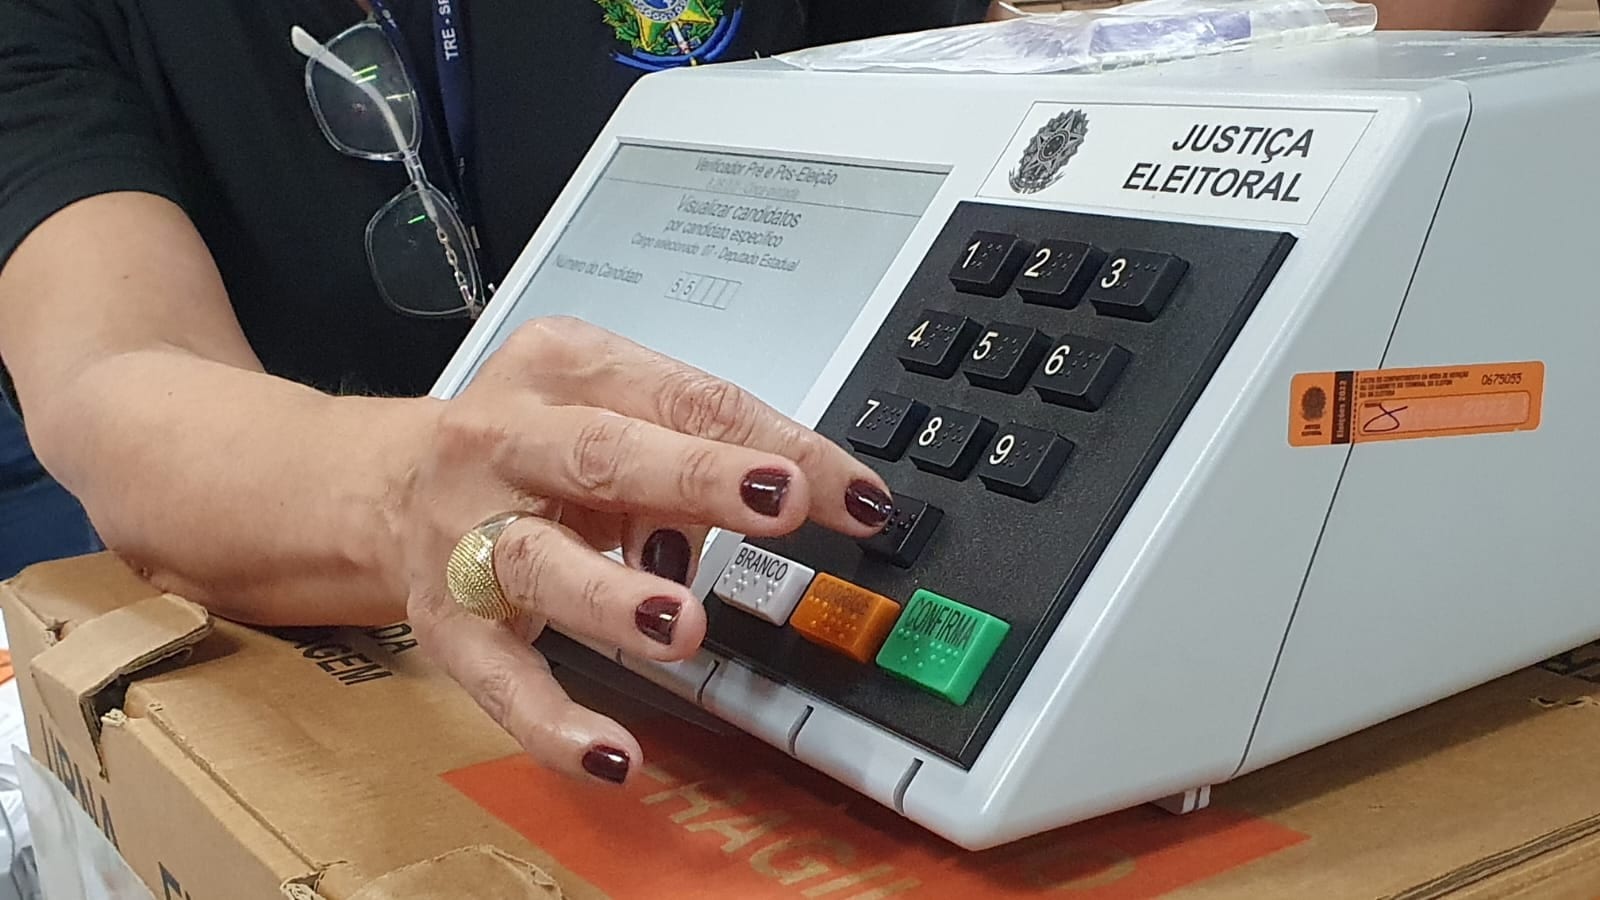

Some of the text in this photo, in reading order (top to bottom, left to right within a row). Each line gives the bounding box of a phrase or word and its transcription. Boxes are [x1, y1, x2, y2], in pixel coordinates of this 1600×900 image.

[441, 27, 459, 61] TRE
[1171, 123, 1314, 163] JUSTIÇA
[1122, 163, 1302, 203] ELEITORAL
[676, 194, 803, 229] Visualizar candidatos
[663, 218, 684, 234] por
[683, 219, 730, 241] candidato
[597, 263, 643, 285] Candidato
[717, 246, 759, 265] Deputado
[759, 253, 800, 273] Estadual
[961, 240, 1127, 289] 1 2 3
[906, 320, 1071, 376] 4 5 6
[1481, 372, 1523, 386] 0675055
[855, 399, 1015, 465] 7 8 9
[734, 547, 789, 582] BRANCO
[905, 596, 978, 650] CONFIRMA
